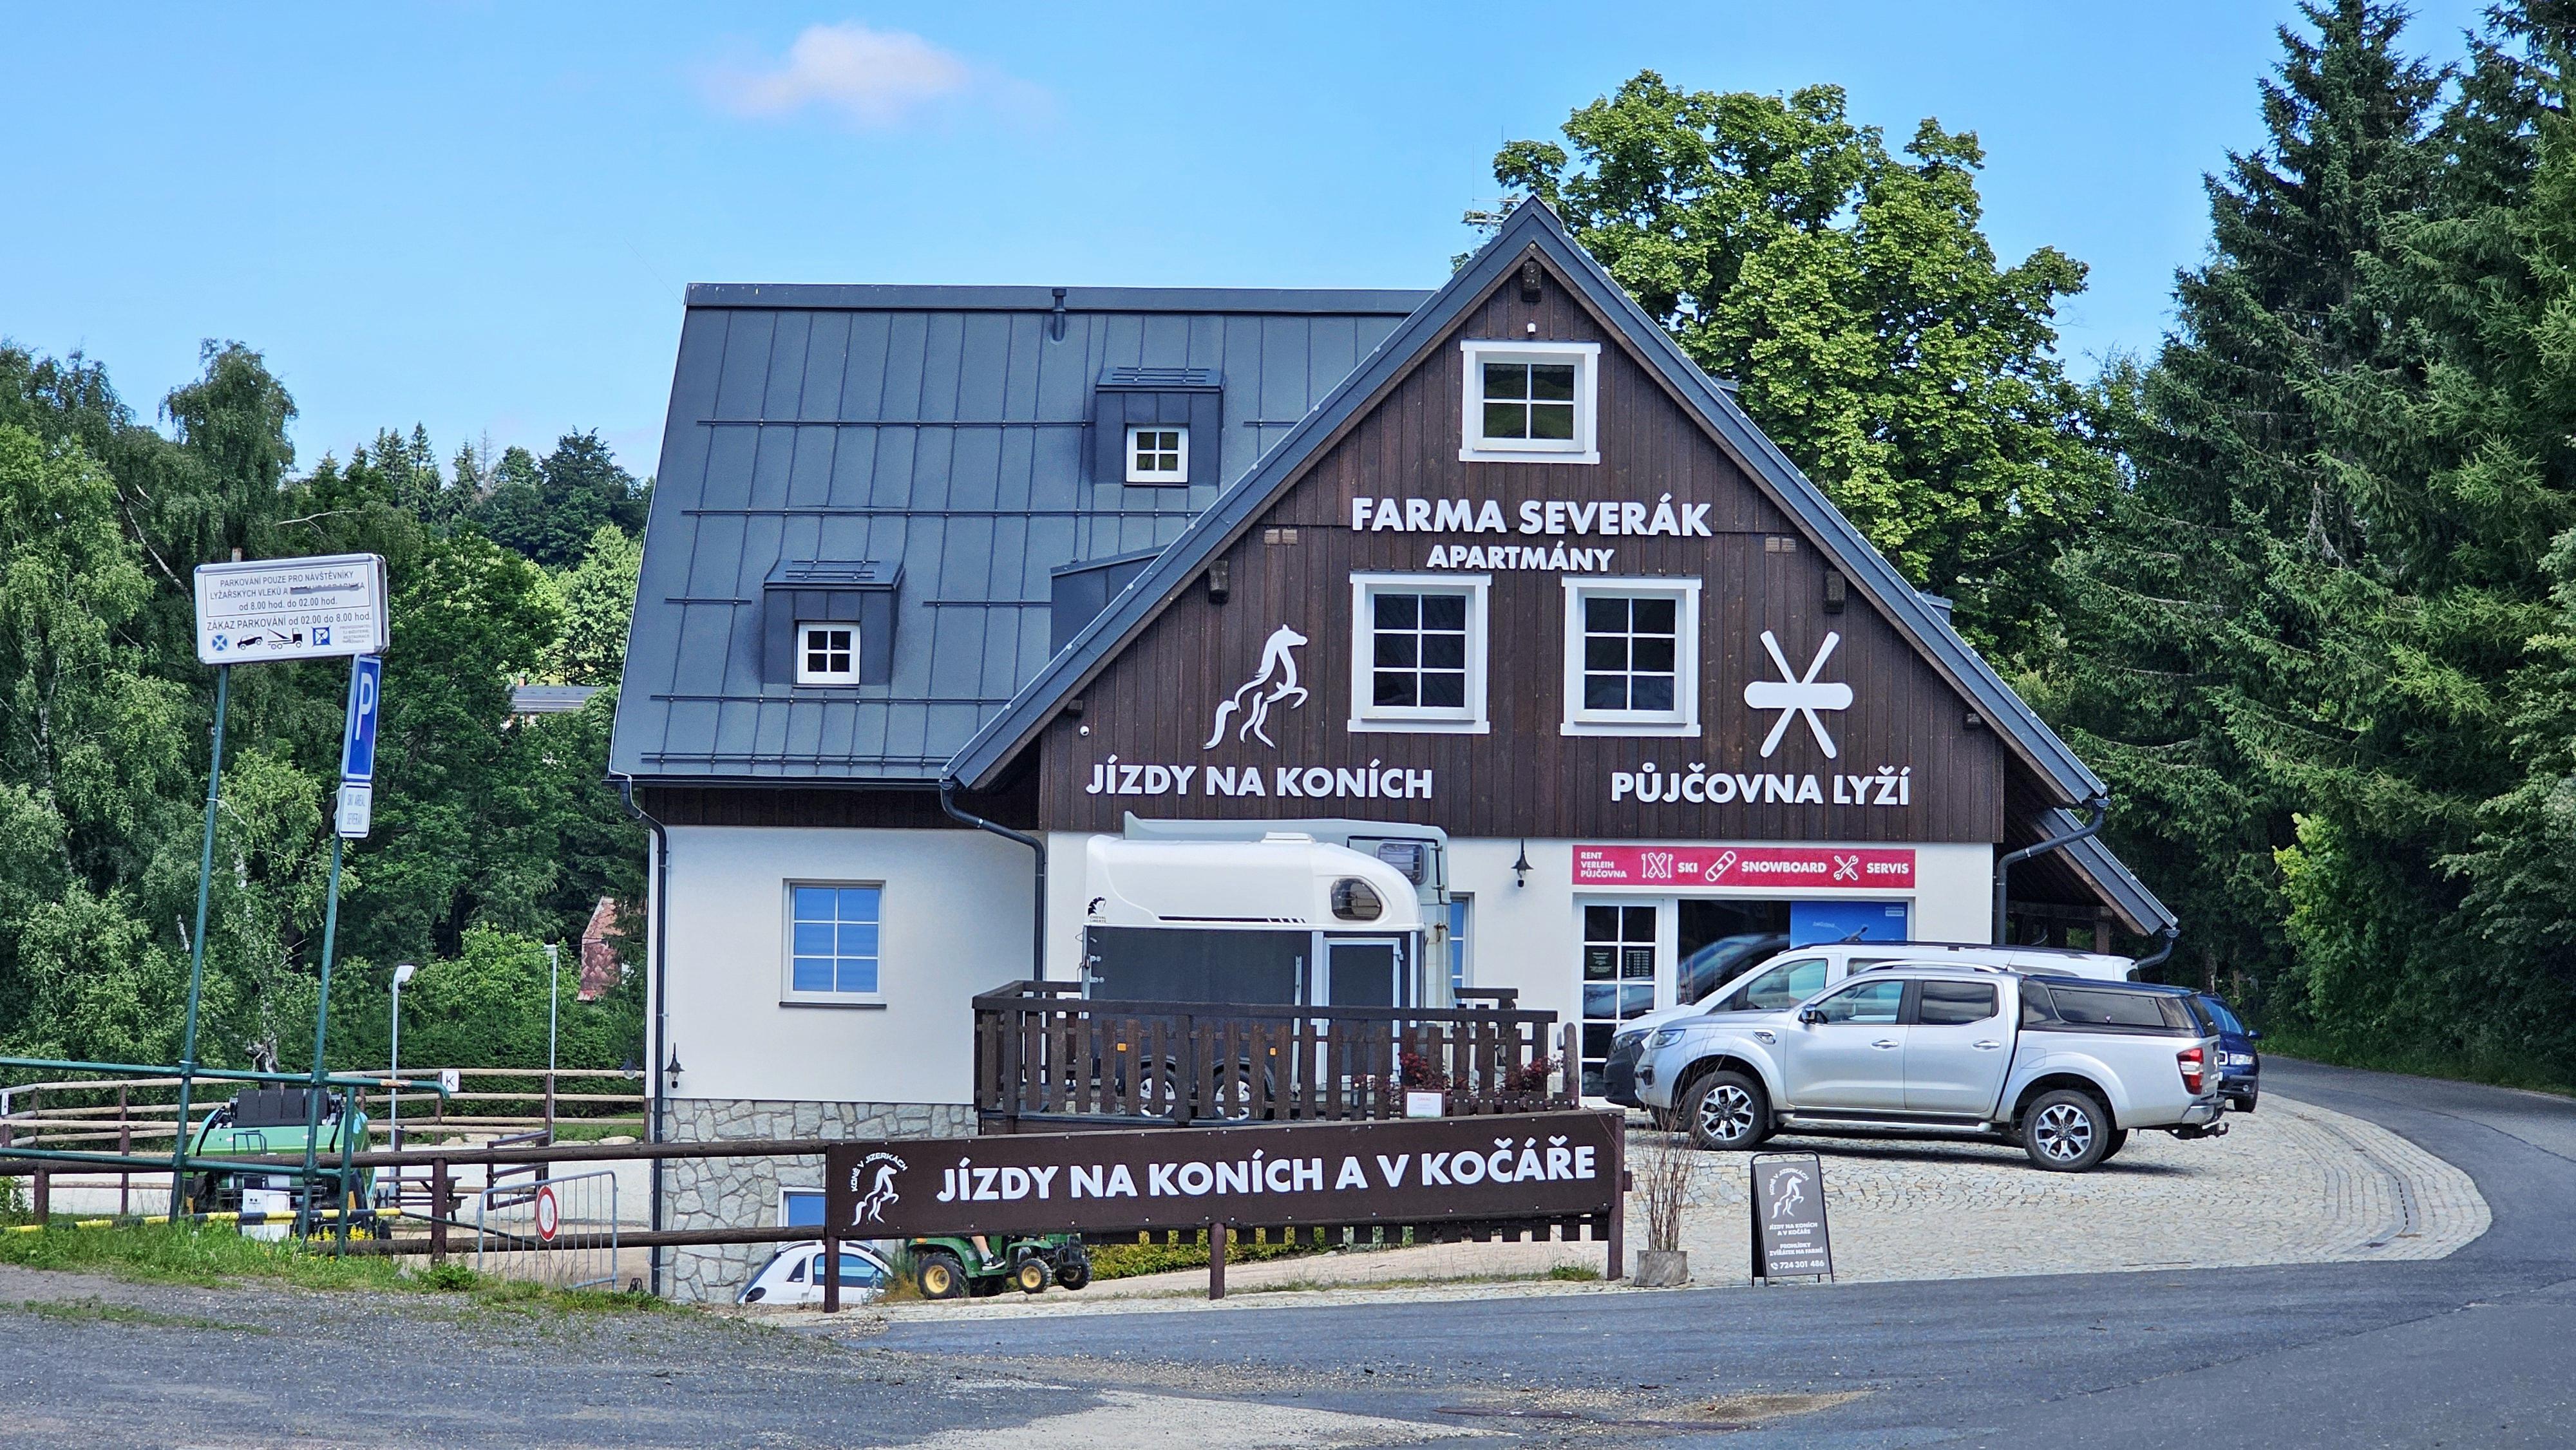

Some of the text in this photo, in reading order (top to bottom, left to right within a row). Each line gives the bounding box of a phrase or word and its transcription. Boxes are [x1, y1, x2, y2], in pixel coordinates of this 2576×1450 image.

[1352, 493, 1712, 537] FARMA SEVERÁK
[1426, 541, 1615, 572] APARTMÁNY
[220, 570, 354, 587] PARKOVÁNÍ POUZE PRO NÁVŠTĚVNÍKY
[210, 588, 256, 600] LYŽAŘSKÝCH
[258, 586, 281, 596] VLEKŮ
[239, 596, 337, 611] od 8.00 hod. do 02.00 hod.
[207, 611, 372, 631] ZÁKAZ PARKOVÁNÍ od 02.00 do 8.00 hod.
[355, 672, 374, 740] P
[1086, 754, 1432, 799] JÍZDY NA KONÍCH
[1611, 762, 1911, 806] PŮJČOVNA LYŽÍ
[1580, 869, 1627, 878] PŮJČOVNA
[1678, 861, 1909, 874] SKI SNOWBOARD SERVIS
[446, 1075, 455, 1087] K
[865, 1153, 908, 1171] JIZERKÁCH
[936, 1135, 1595, 1201] JÍZDY NA KONÍCH A V KOČÁŘE
